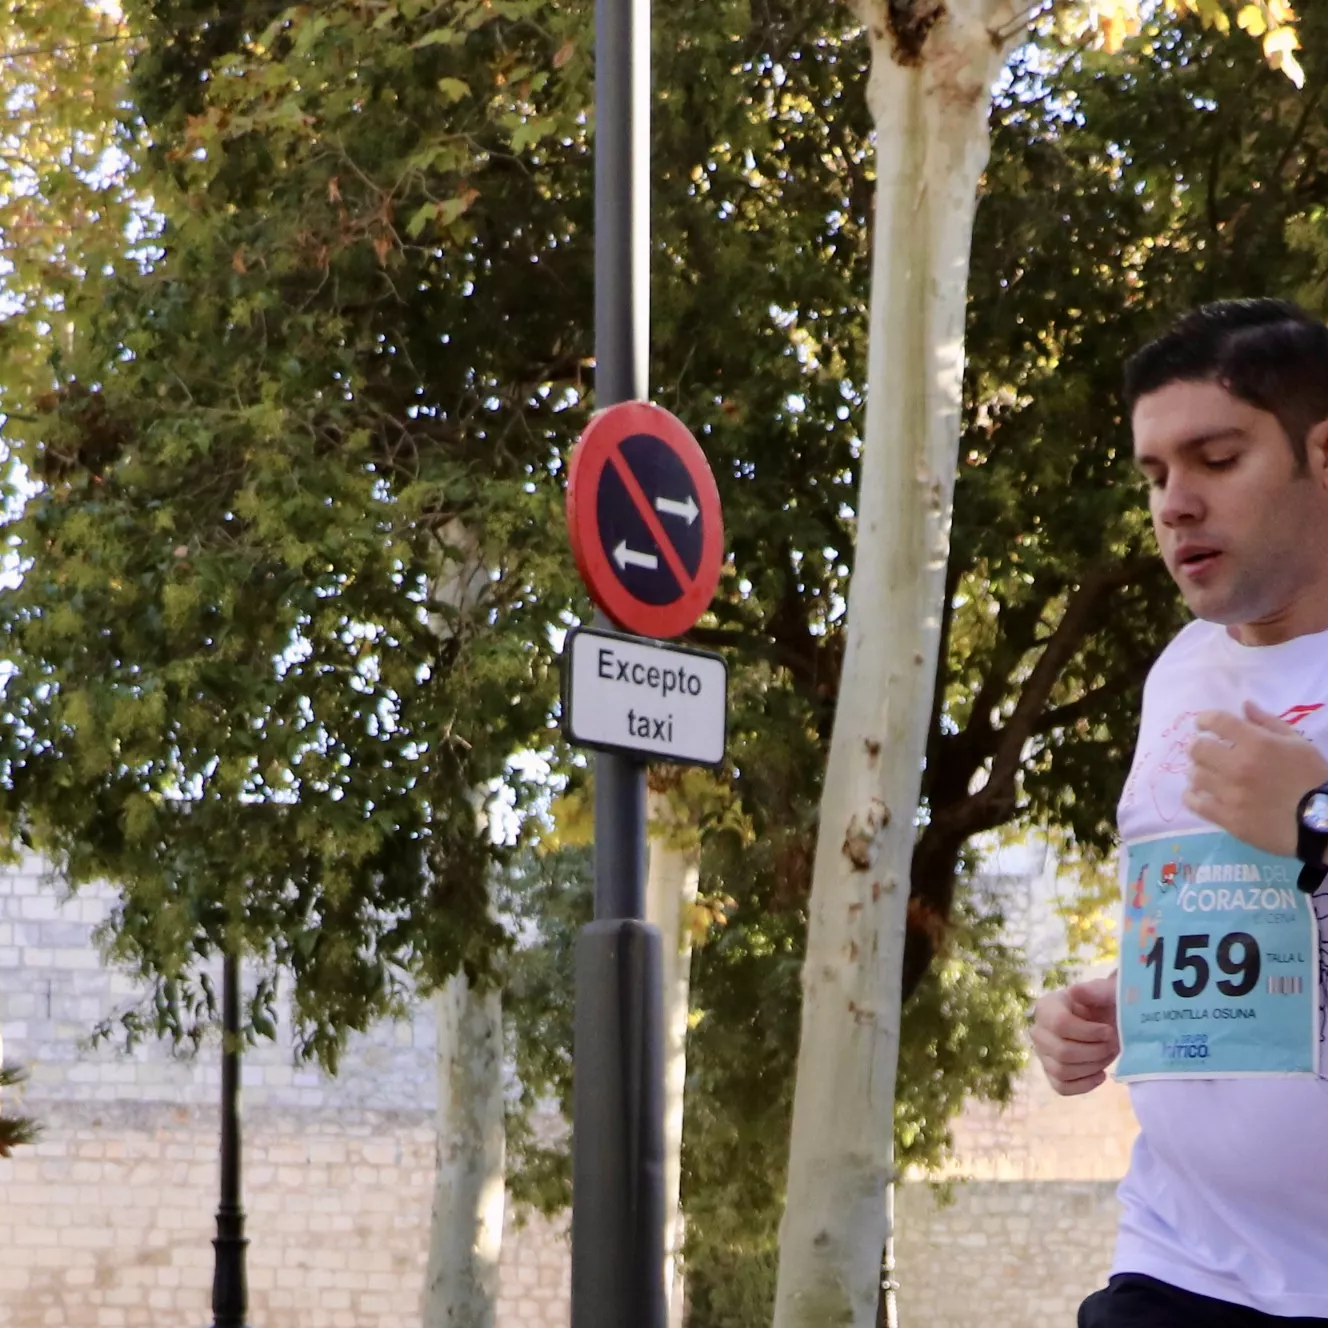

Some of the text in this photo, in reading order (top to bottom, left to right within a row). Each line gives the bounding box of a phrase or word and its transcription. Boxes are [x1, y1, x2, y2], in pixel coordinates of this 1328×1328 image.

[598, 648, 702, 697] Excepto
[627, 708, 673, 742] taxi
[1196, 863, 1261, 884] CARRERA
[1262, 865, 1291, 882] DEL
[1145, 931, 1261, 1000] 159
[1266, 952, 1305, 963] TALLA L
[1163, 1009, 1209, 1020] MONTILLA
[1212, 1007, 1257, 1020] OSUNA
